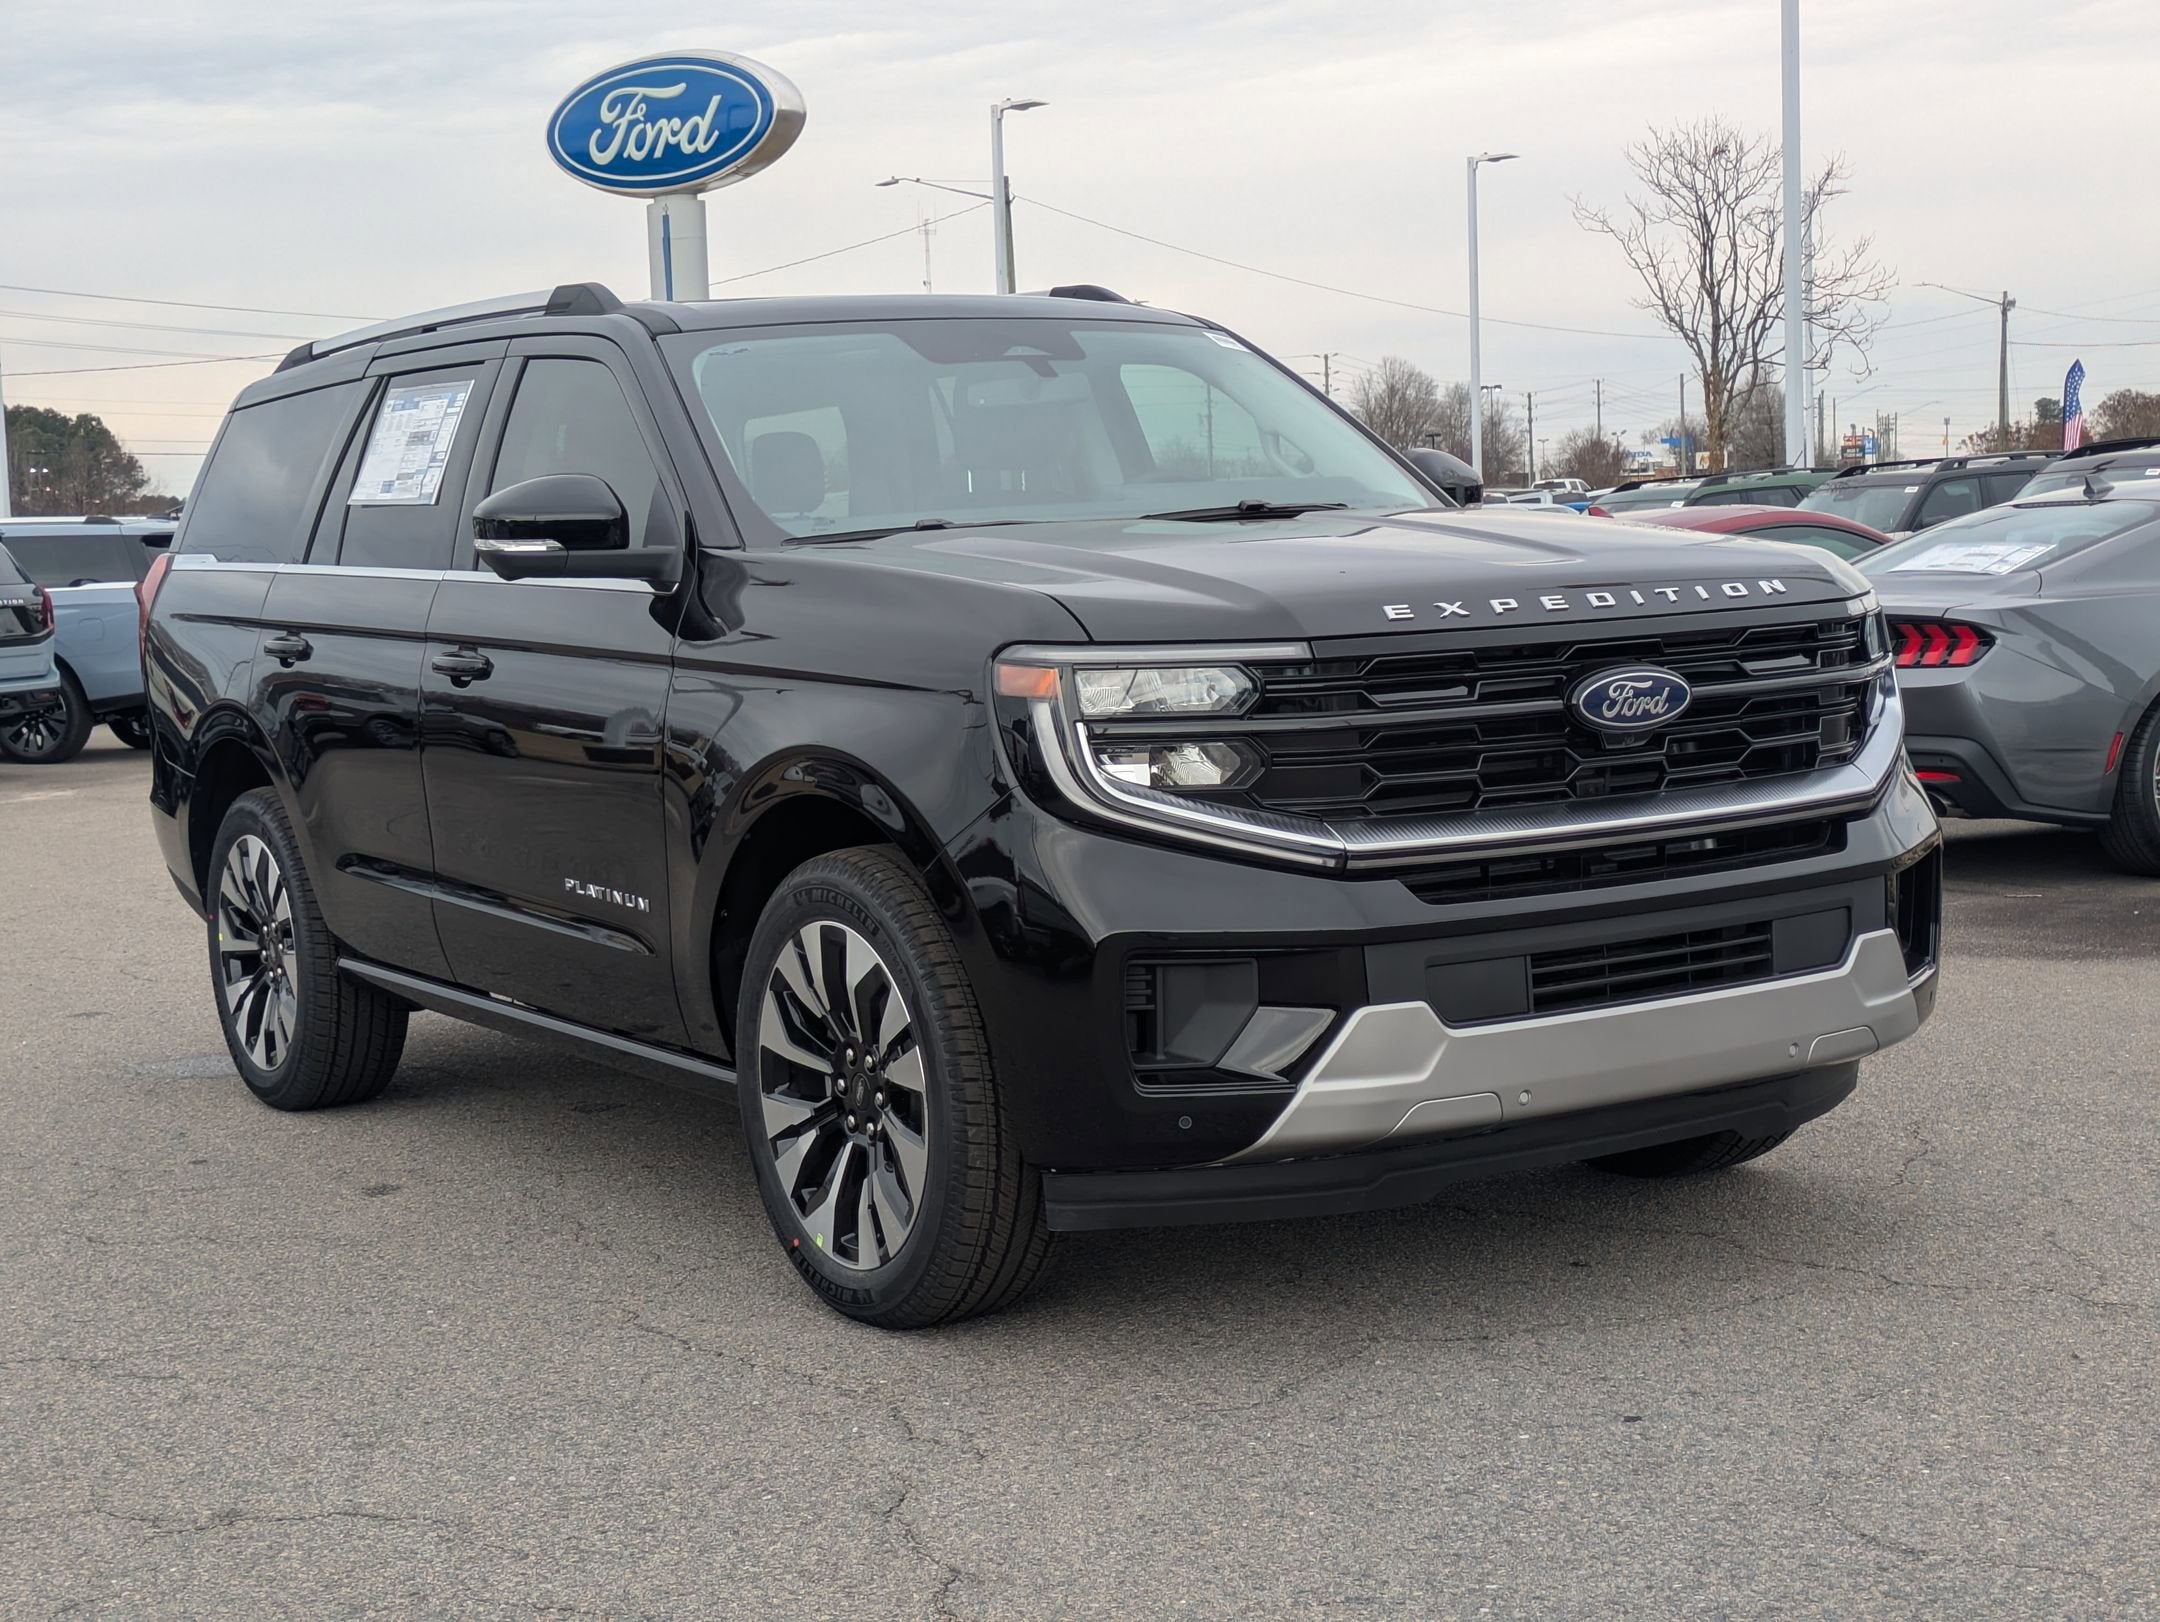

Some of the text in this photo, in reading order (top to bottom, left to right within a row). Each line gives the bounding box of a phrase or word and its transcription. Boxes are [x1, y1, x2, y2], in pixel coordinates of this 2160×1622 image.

[589, 82, 722, 165] Ford
[1382, 579, 1787, 621] EXPEDITION
[1602, 680, 1670, 718] Ford
[564, 878, 650, 913] PLATINUM
[811, 888, 877, 933] MICHELIN
